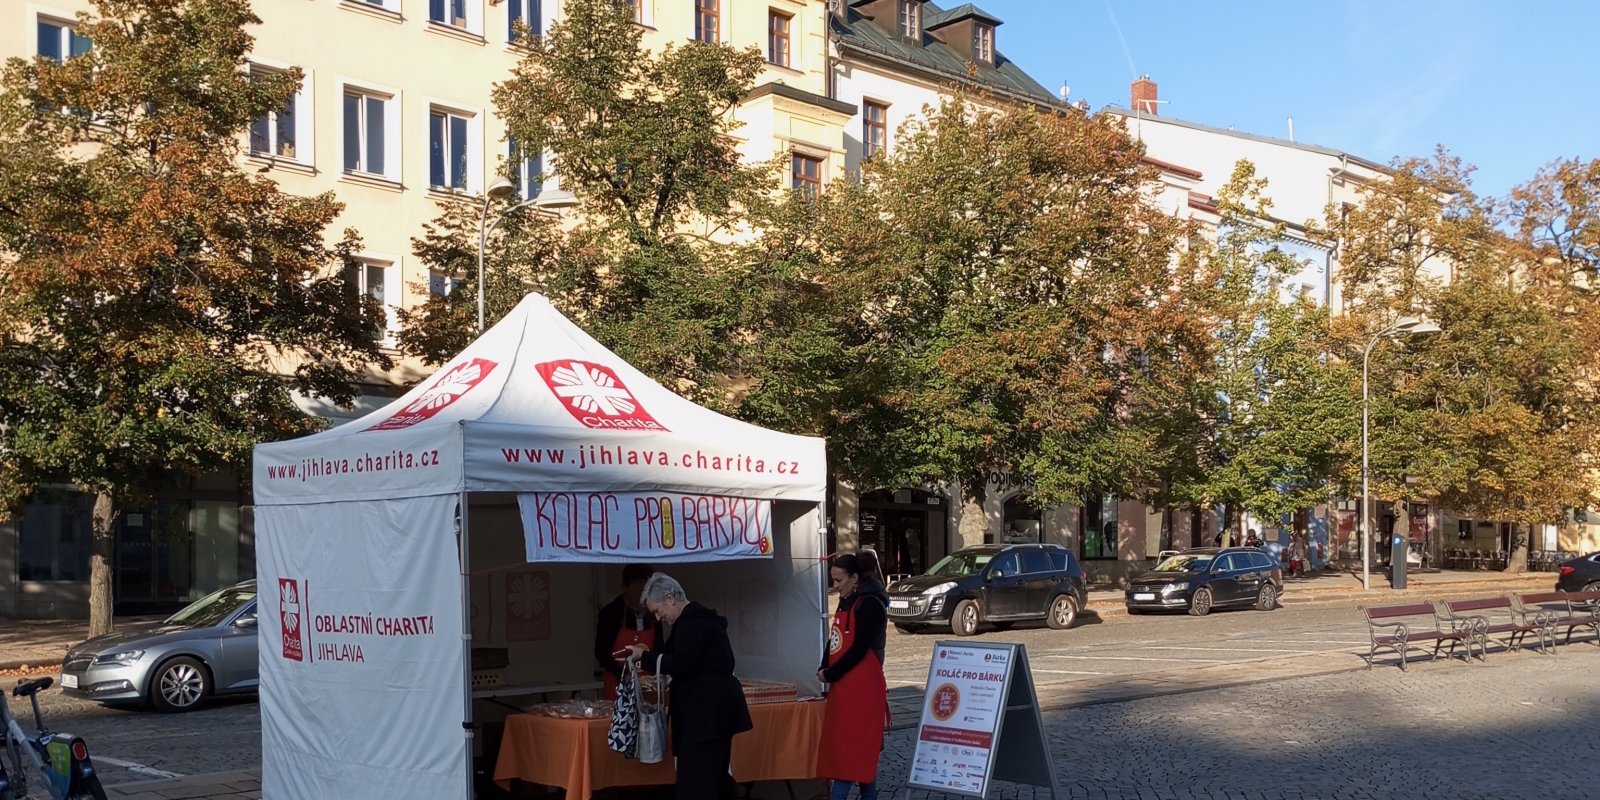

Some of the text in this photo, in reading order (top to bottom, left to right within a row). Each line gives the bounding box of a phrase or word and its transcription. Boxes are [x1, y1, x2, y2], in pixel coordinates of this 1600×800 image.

[582, 416, 662, 429] Charita
[268, 449, 439, 482] www.jihlava.charita.cz
[501, 445, 799, 475] www.jihlava.charita.cz
[633, 497, 676, 550] PRO
[315, 612, 434, 636] OBLASTNÍ CHARITA
[318, 643, 365, 663] JIHLAVA
[936, 667, 1005, 682] KOLÁČ PRO BÁRKU
